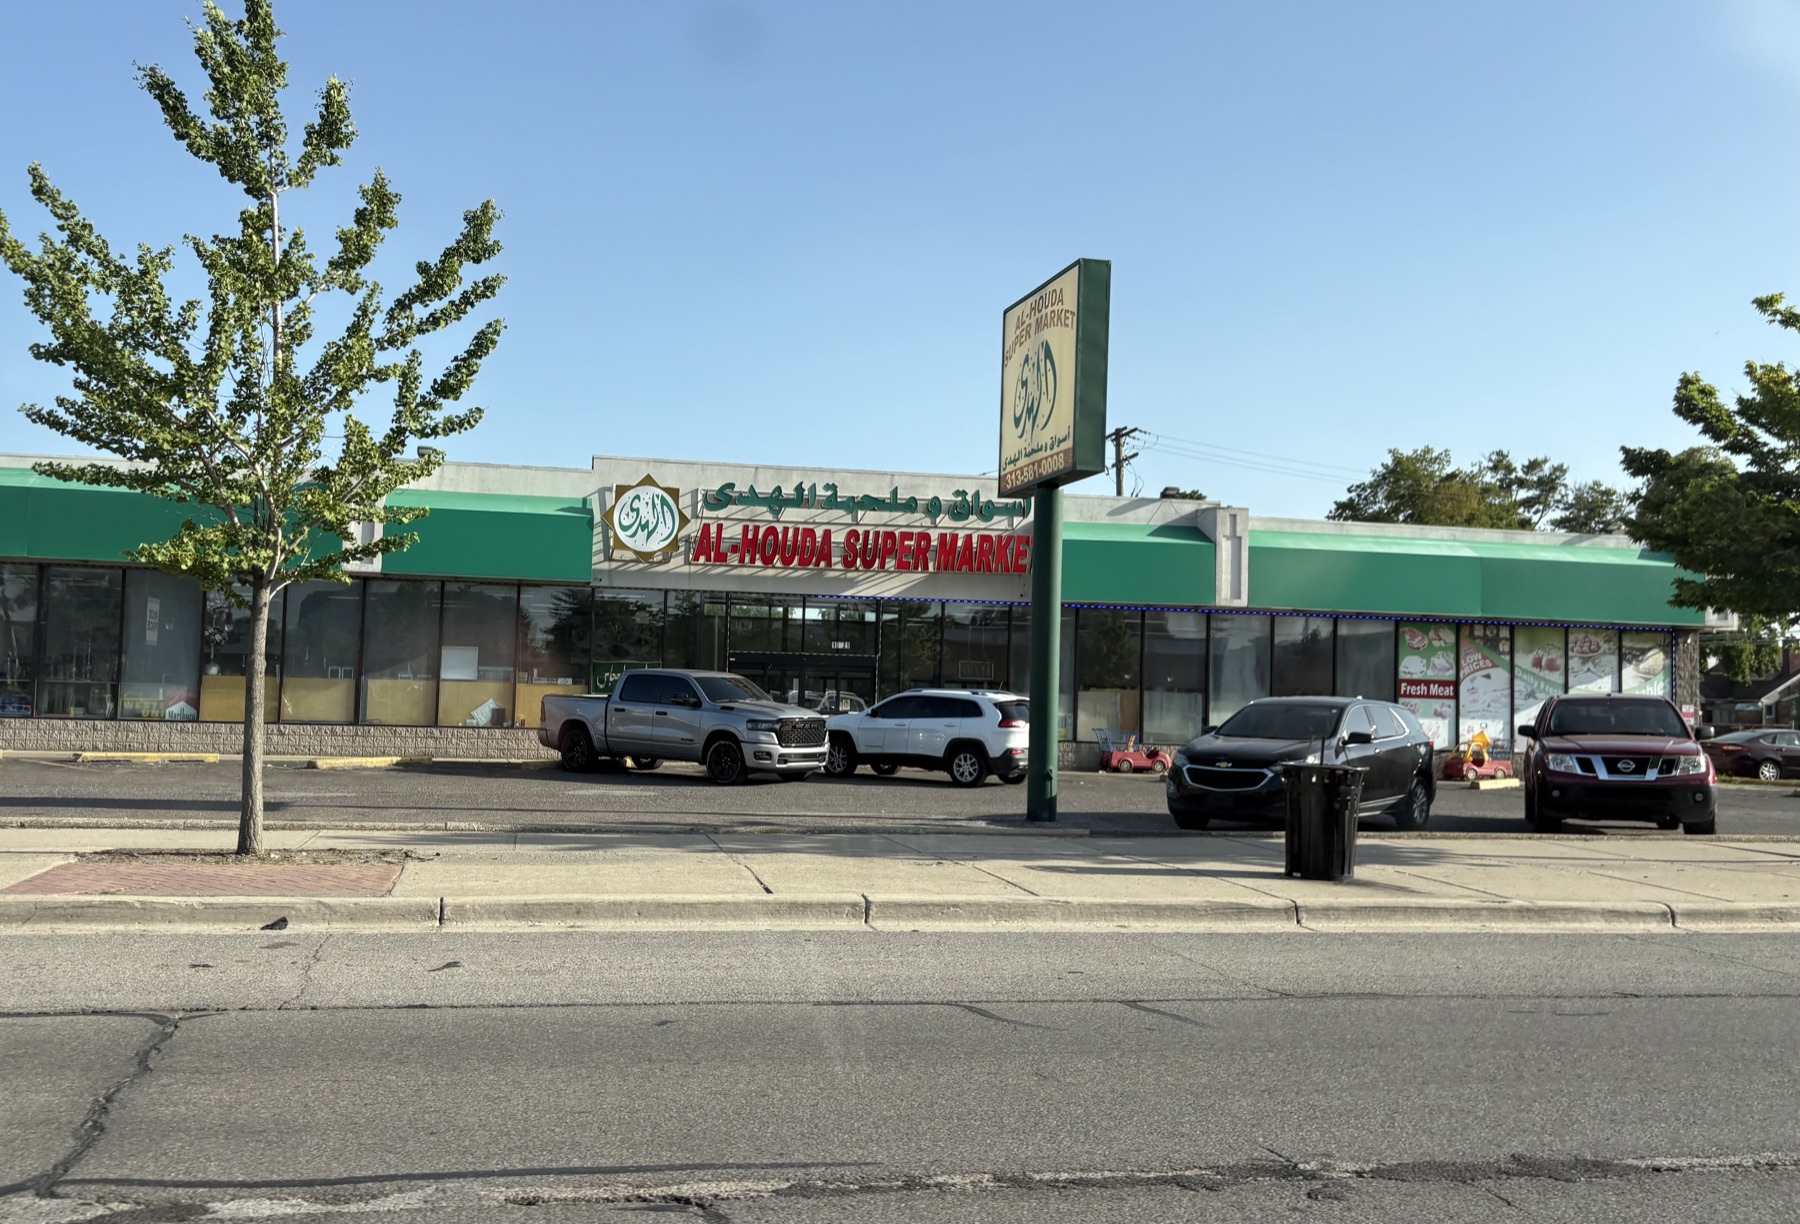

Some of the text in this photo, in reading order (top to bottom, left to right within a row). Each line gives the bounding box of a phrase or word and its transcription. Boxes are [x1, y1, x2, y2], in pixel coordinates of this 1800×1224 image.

[1014, 287, 1064, 335] AL-HOUDA
[1005, 308, 1076, 368] SUPER MARKET
[1006, 452, 1065, 489] 313-581-0008
[702, 481, 817, 516] الهدى
[691, 523, 1034, 575] AL-HOUDA SUPER MARKE
[1459, 659, 1492, 681] PRICES
[1461, 652, 1482, 667] LOW
[1400, 682, 1455, 697] Fresh Meat
[1515, 667, 1539, 688] Daily
